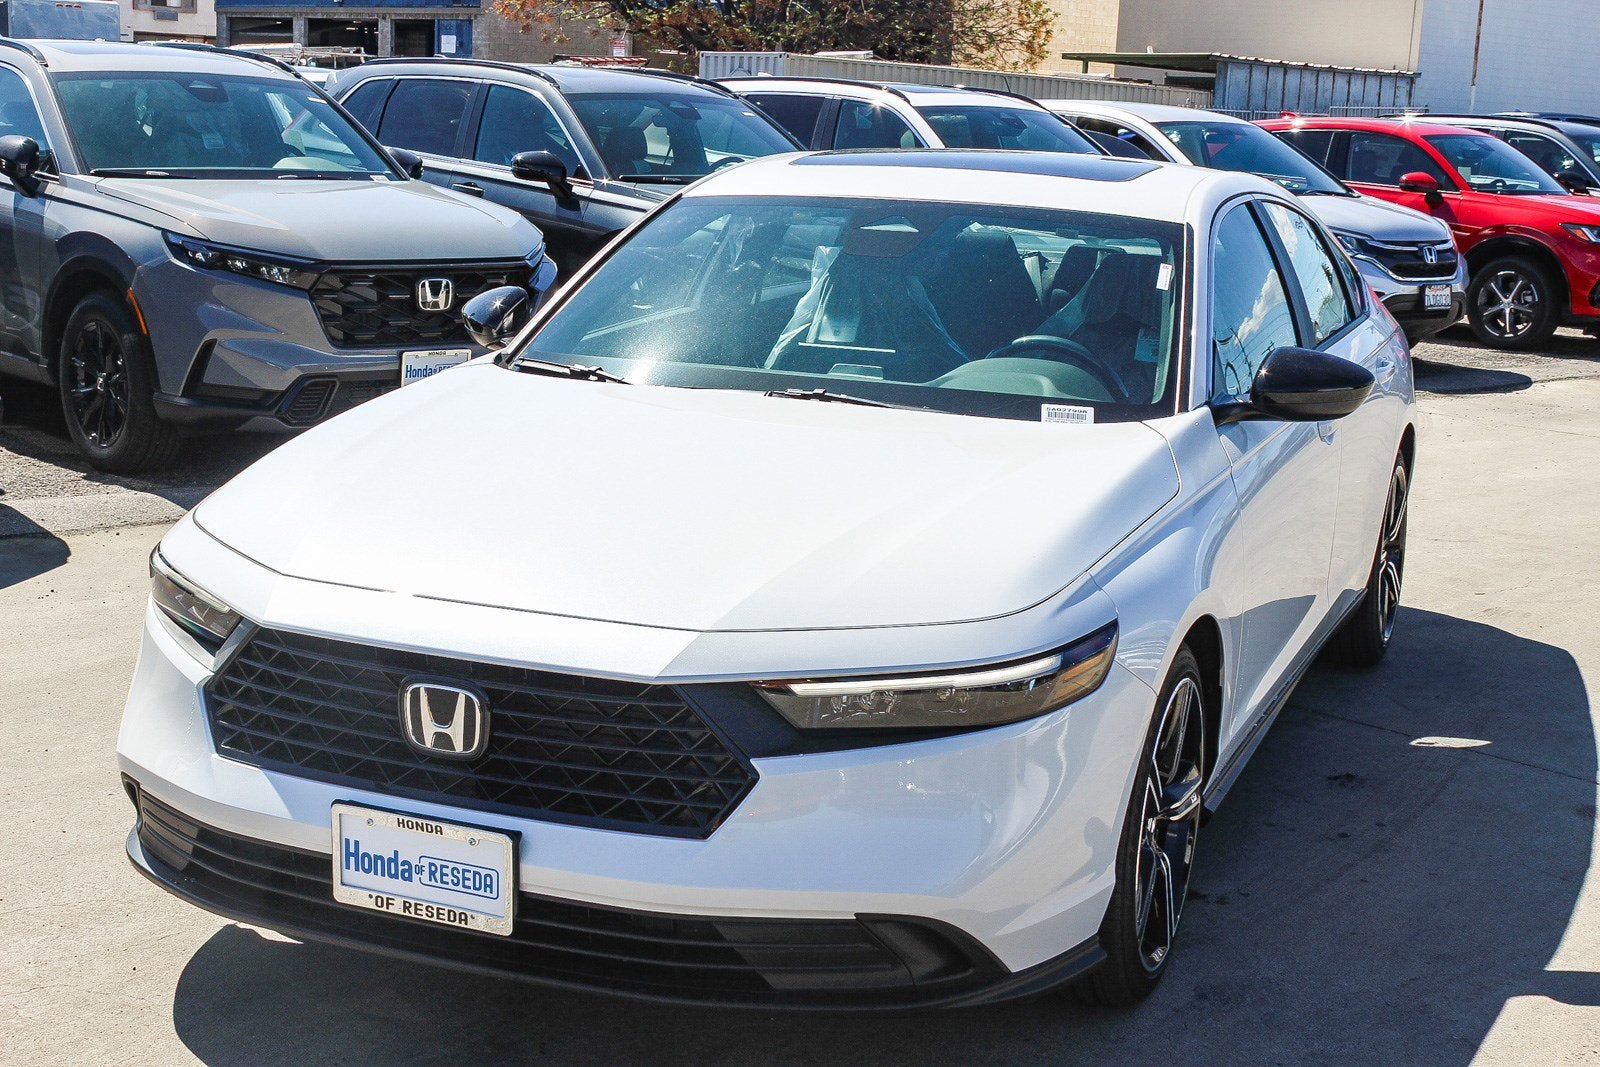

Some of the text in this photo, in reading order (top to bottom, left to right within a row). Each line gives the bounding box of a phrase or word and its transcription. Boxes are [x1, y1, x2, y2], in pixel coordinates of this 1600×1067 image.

[405, 365, 433, 378] Honda
[397, 817, 443, 835] HONDA
[344, 837, 494, 895] Honda OF RESEDA
[374, 895, 469, 926] OF RESEDA
